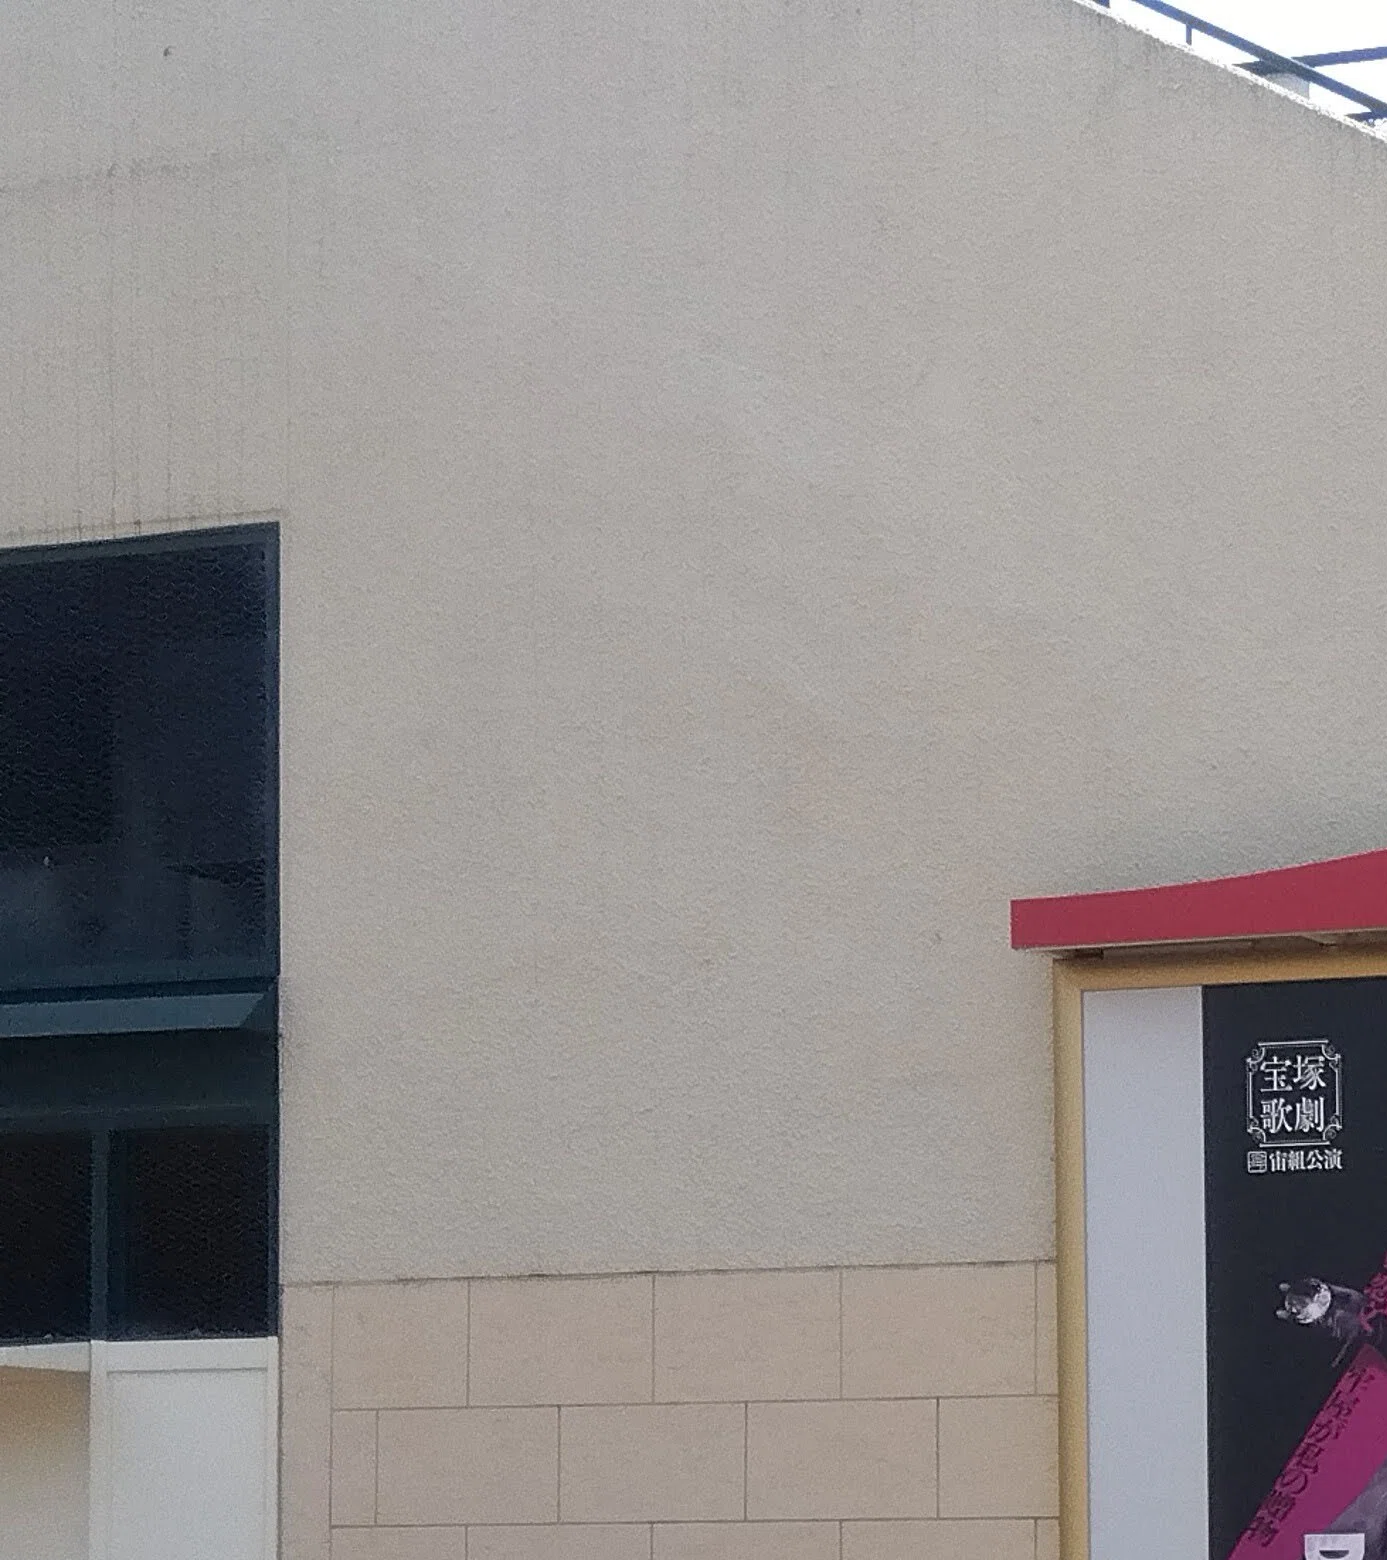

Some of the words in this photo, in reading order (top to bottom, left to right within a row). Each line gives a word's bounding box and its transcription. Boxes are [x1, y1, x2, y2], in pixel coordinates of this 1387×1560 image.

[1260, 1054, 1327, 1092] 宝塚
[1260, 1096, 1325, 1134] 歌劇
[1268, 1148, 1343, 1172] 宙組公演
